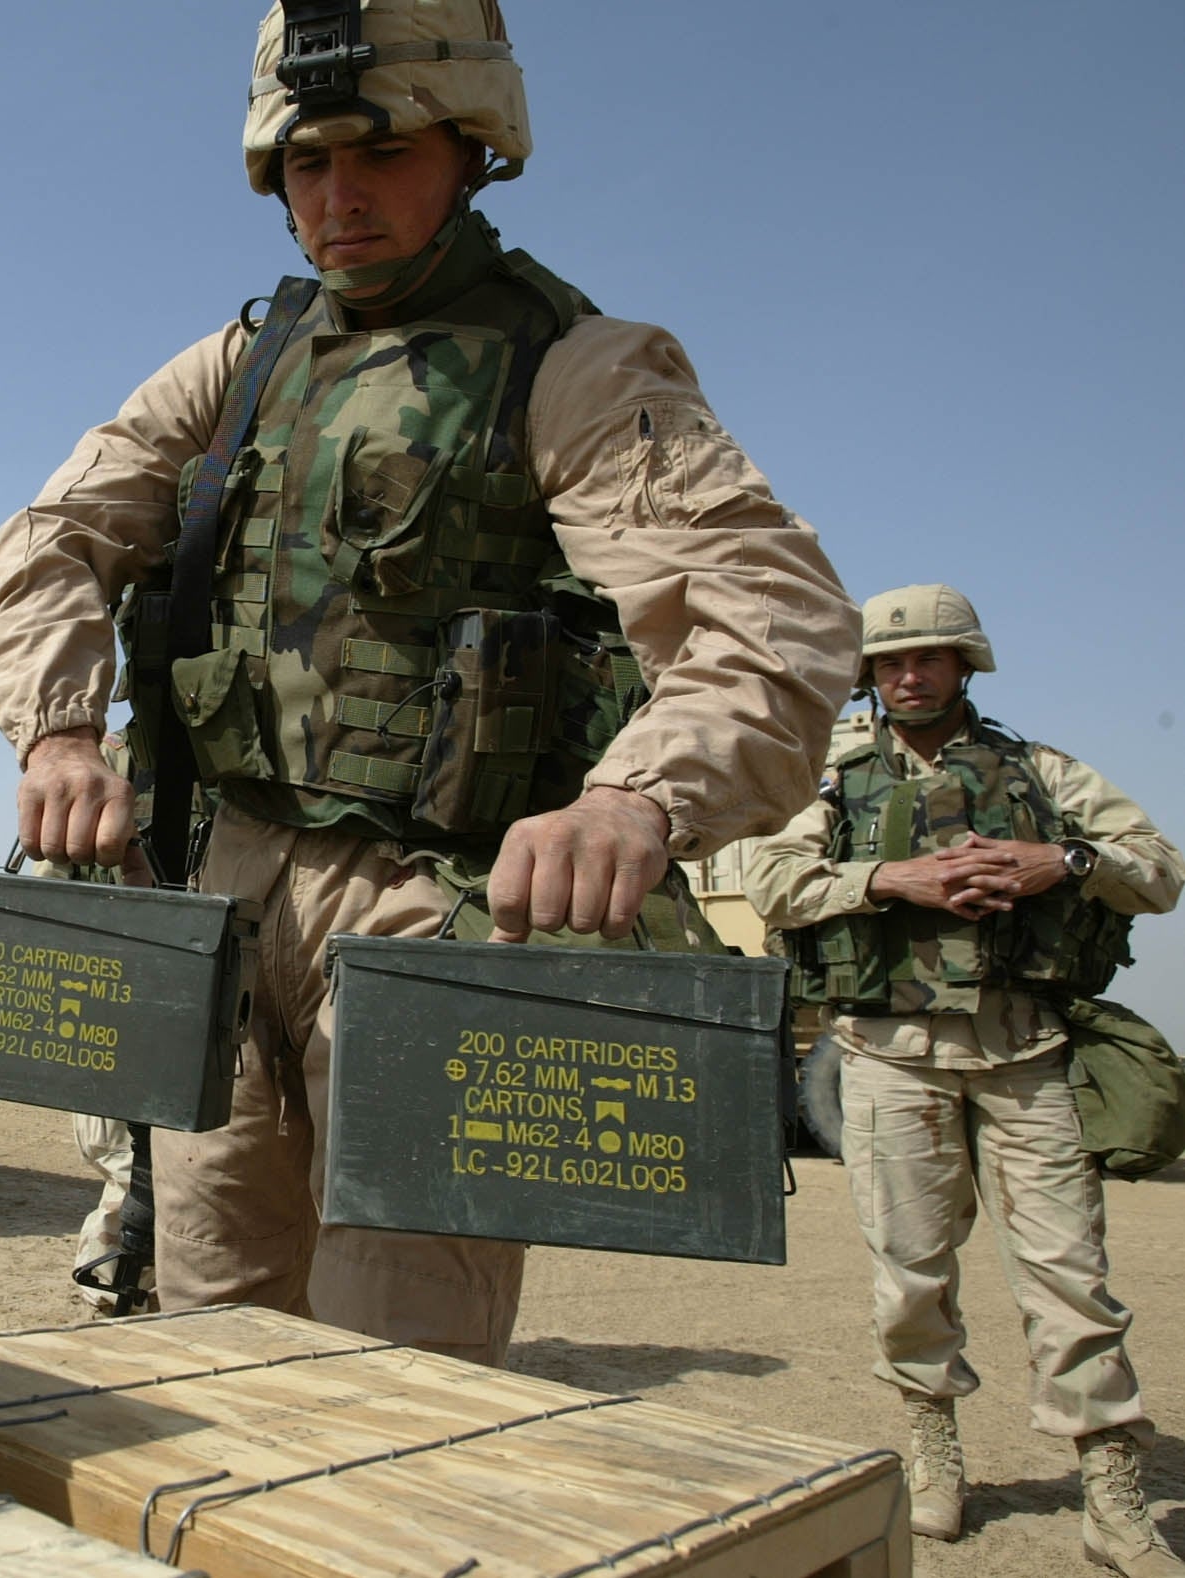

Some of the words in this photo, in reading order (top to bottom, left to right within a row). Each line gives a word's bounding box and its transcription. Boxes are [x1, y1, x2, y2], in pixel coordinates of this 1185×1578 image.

[12, 945, 123, 979] CARTRIDGES
[79, 1023, 118, 1048] M80
[457, 1030, 505, 1057] 200
[516, 1035, 678, 1072] CARTRIDGES
[474, 1060, 527, 1086] 7.62
[534, 1064, 585, 1096] MM,
[465, 1086, 588, 1125] CARTONS,
[448, 1114, 460, 1139] 1
[628, 1131, 685, 1161] M80
